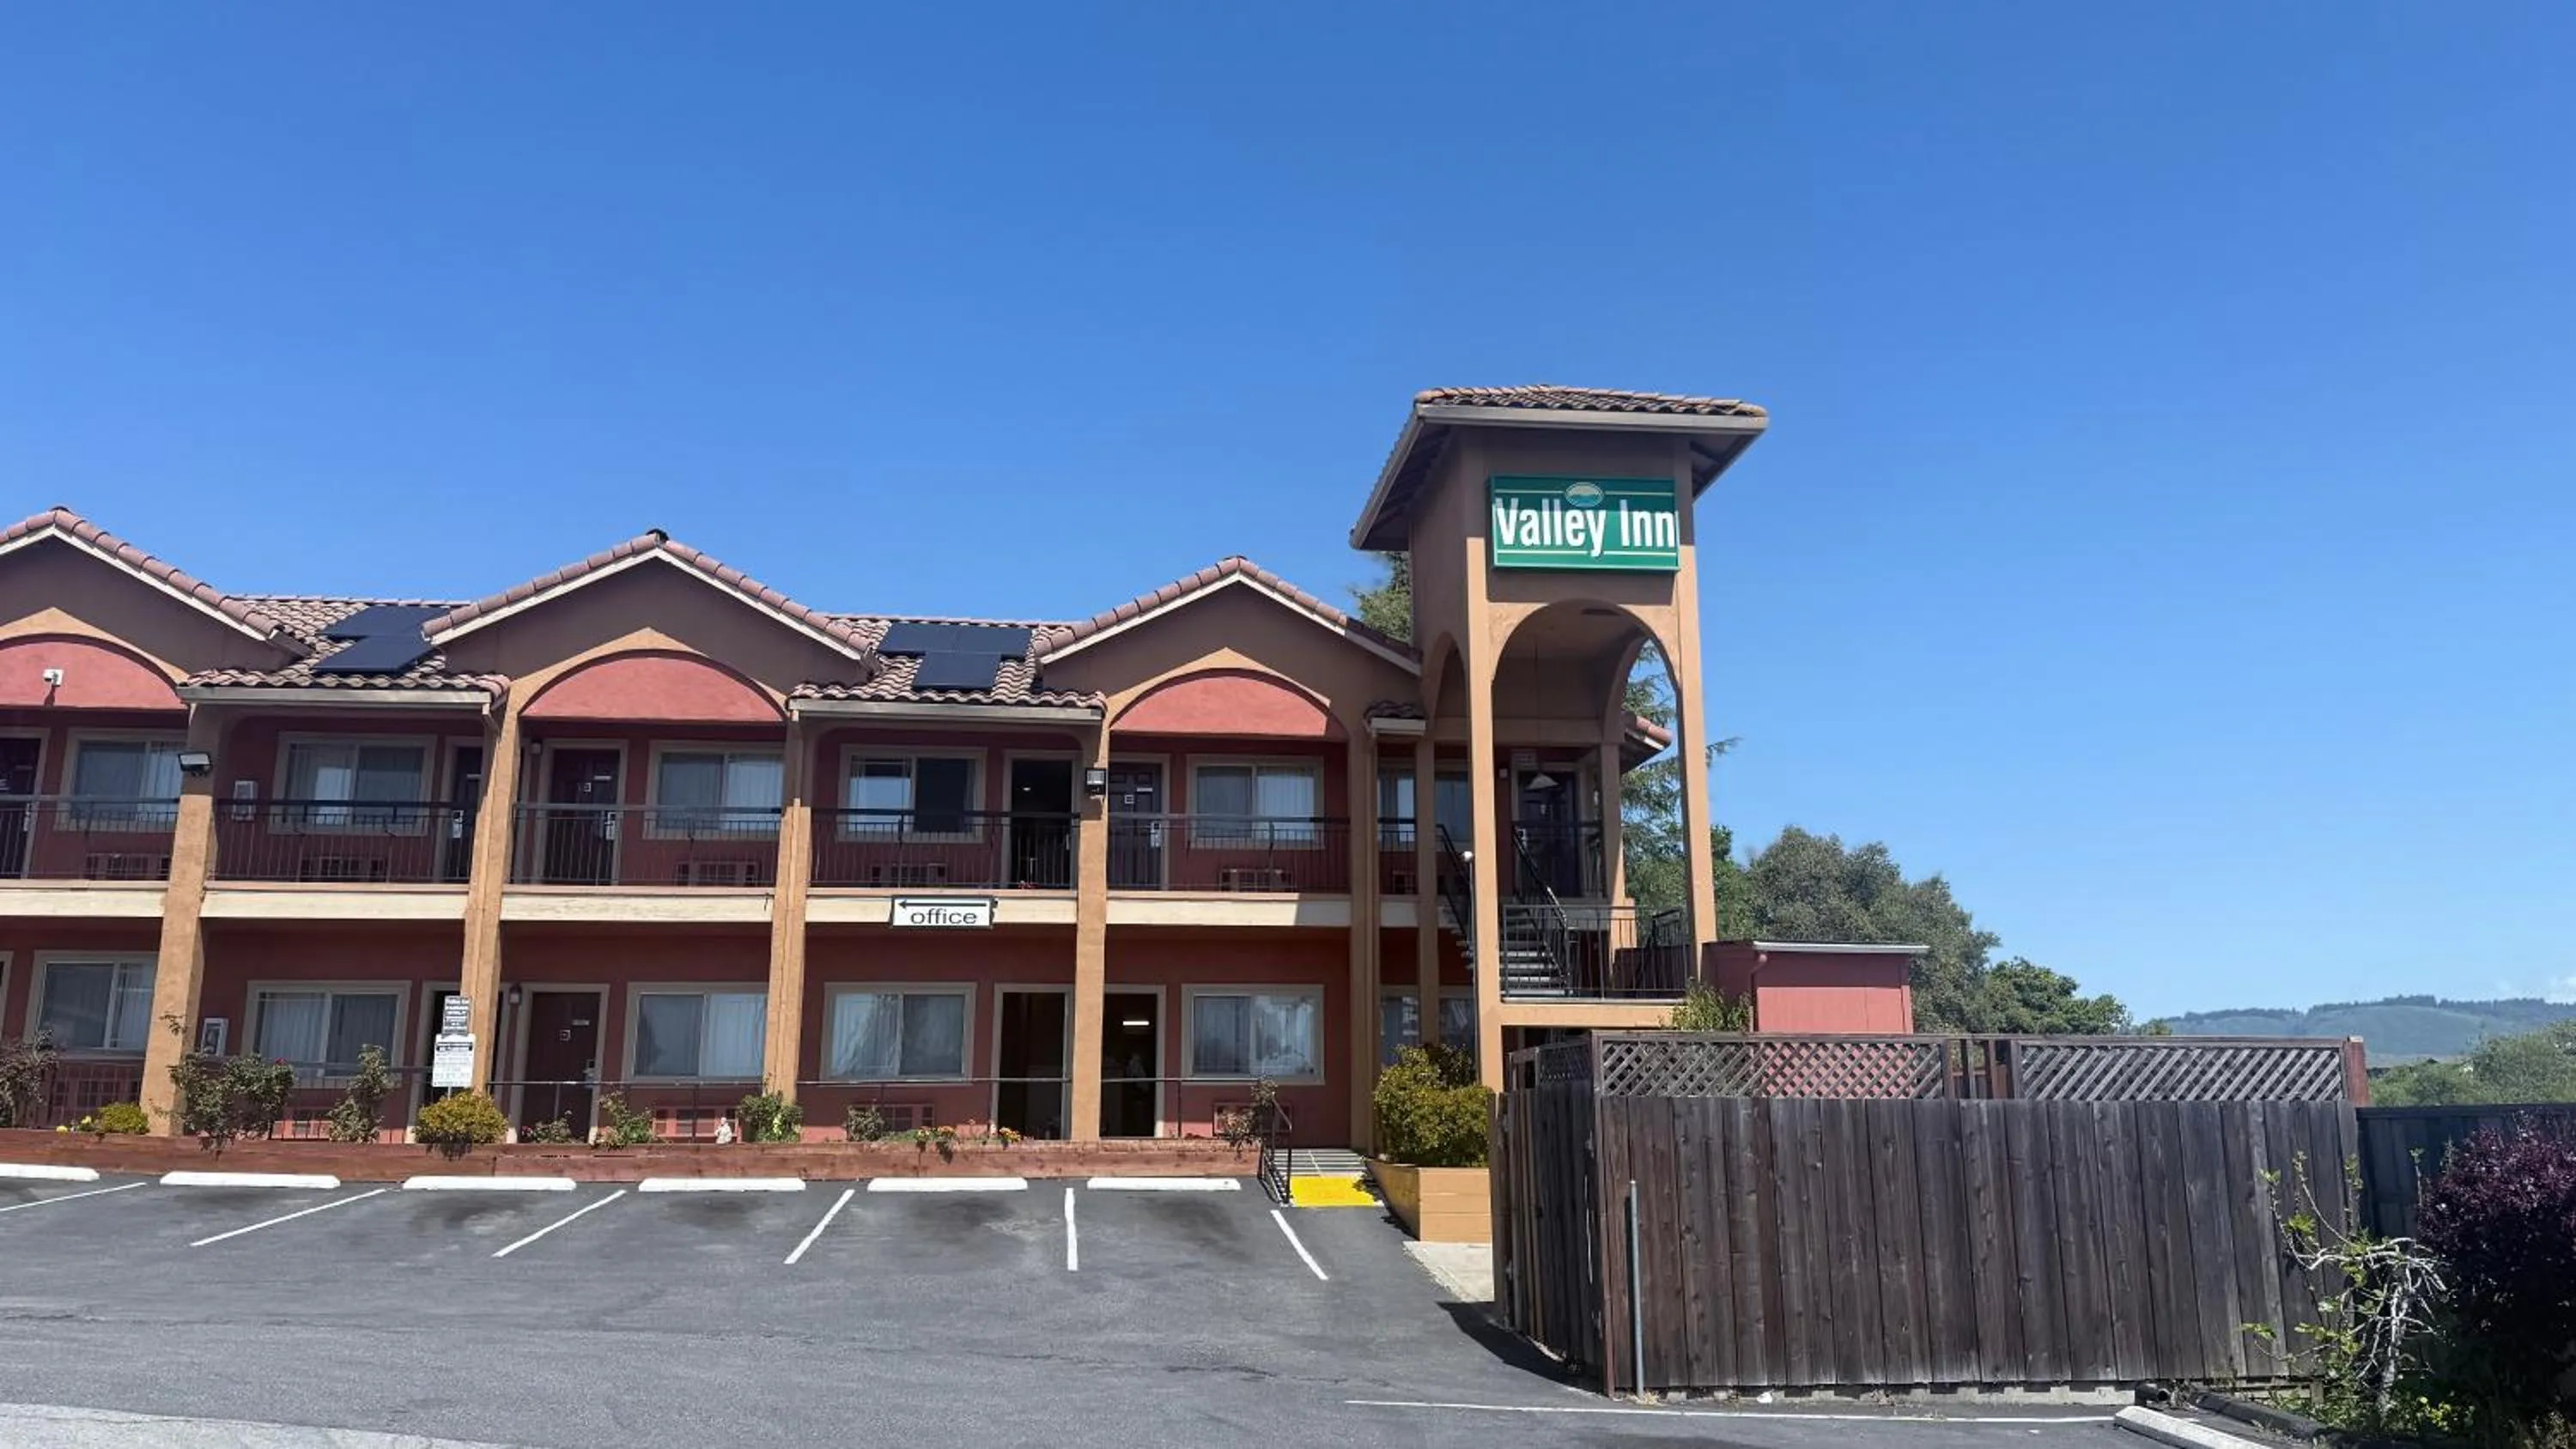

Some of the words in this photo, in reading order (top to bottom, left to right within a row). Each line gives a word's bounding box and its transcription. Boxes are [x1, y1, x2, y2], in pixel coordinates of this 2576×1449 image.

[1495, 497, 1607, 557] Valley
[1619, 499, 1675, 548] Inn
[910, 908, 977, 925] office
